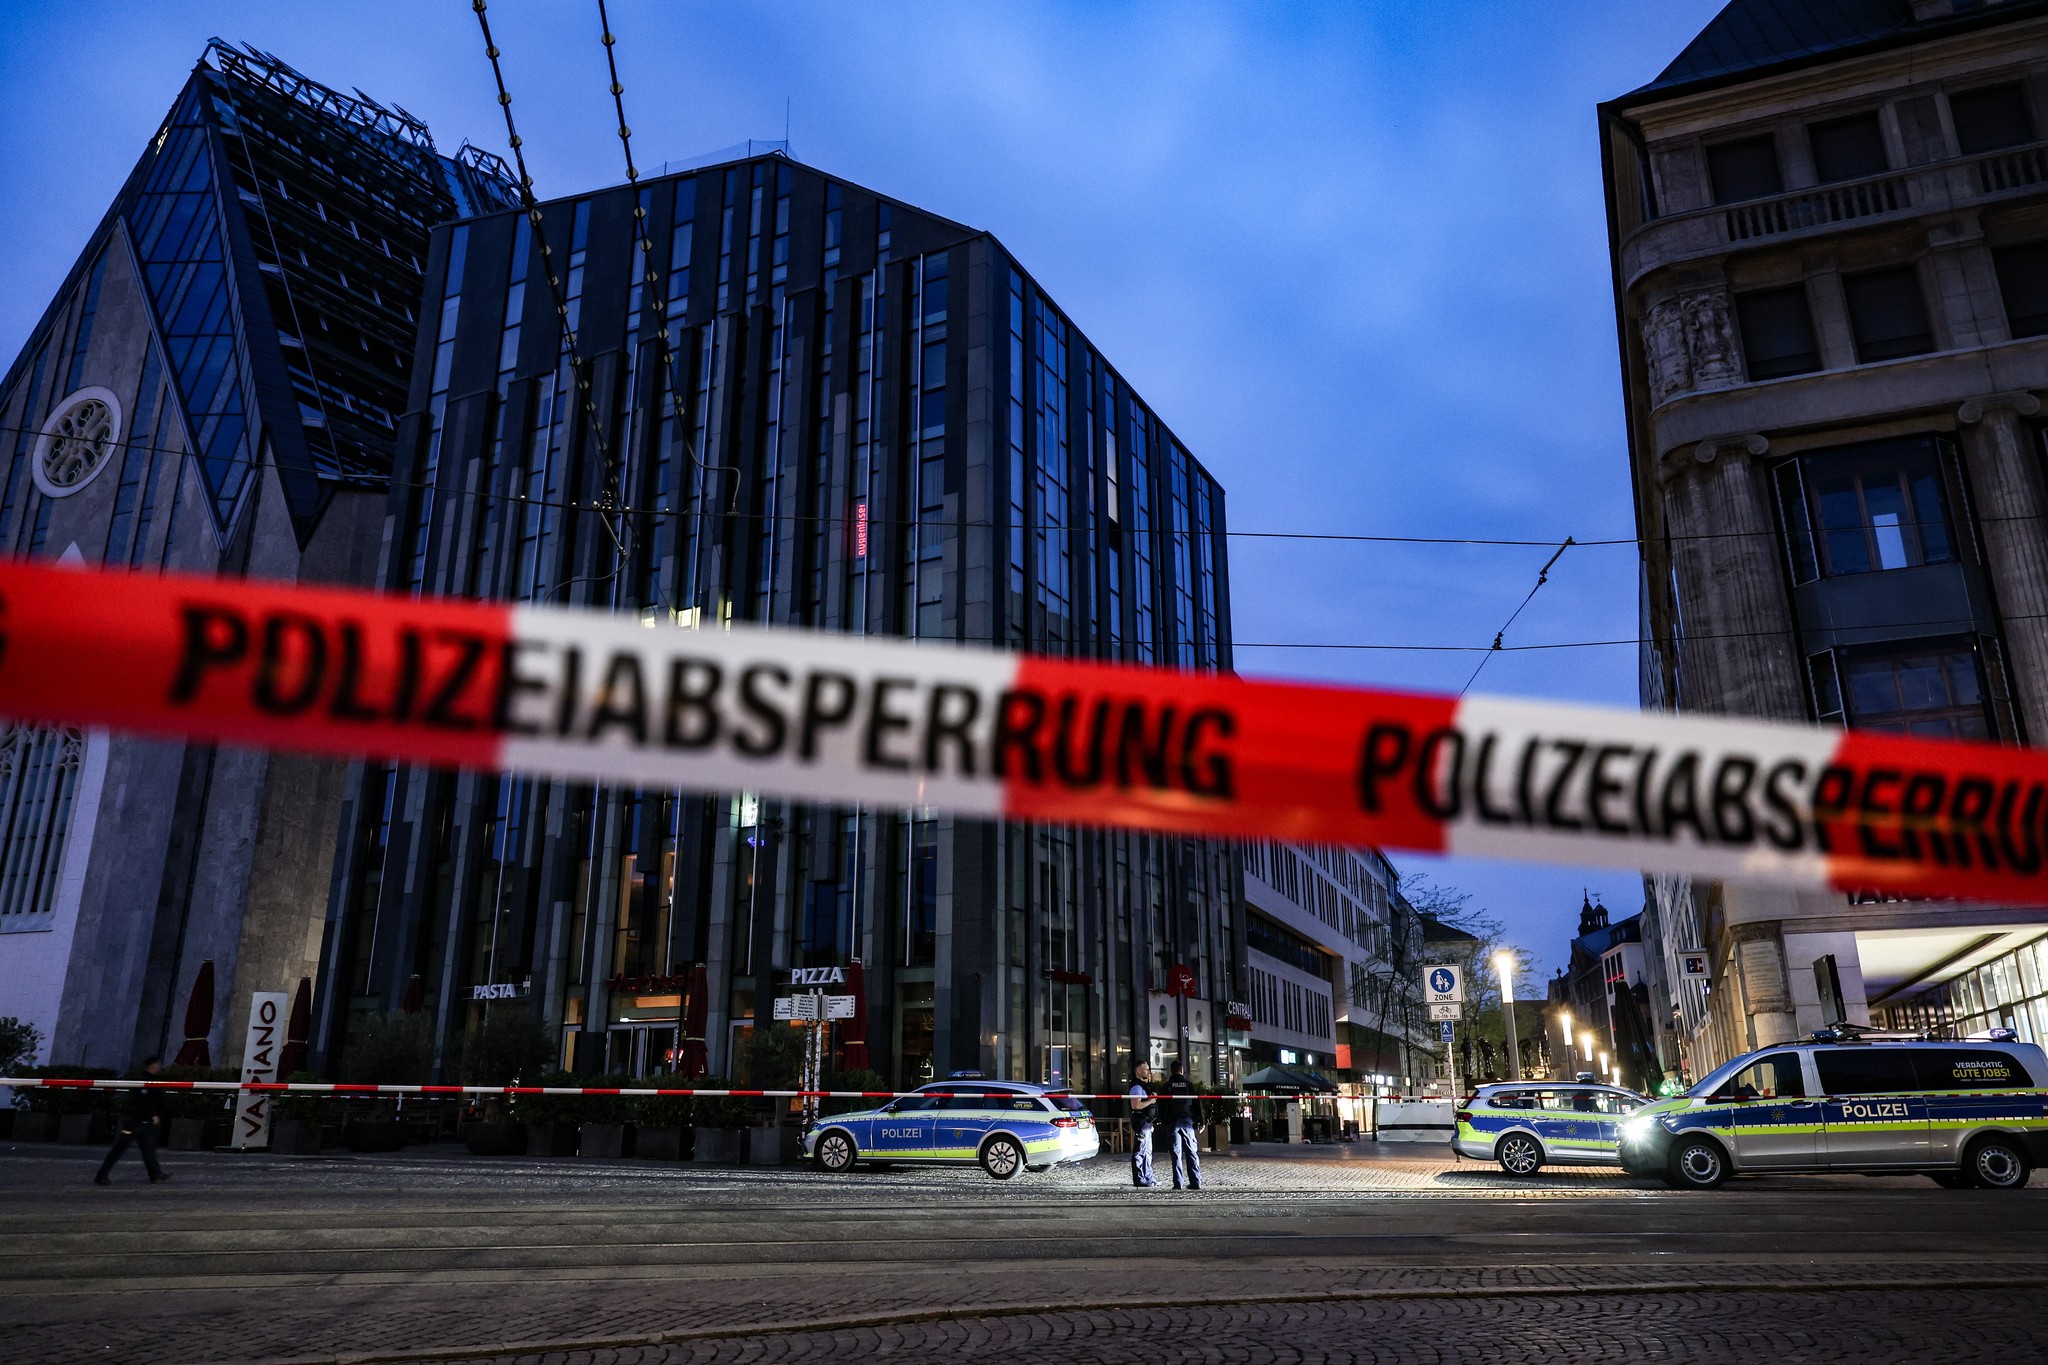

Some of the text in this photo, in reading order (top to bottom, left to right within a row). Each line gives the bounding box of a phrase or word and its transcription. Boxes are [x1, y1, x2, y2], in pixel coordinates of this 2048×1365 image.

[168, 602, 1236, 798] POLIZEIABSPERRUNG
[1358, 718, 2048, 876] POLIZEIABSPERRU
[791, 966, 844, 985] PIZZA
[473, 983, 517, 1000] PASTA
[1228, 1000, 1251, 1017] CENTRAL
[1182, 1026, 1189, 1038] 16
[1952, 1067, 2011, 1078] GUTE JOBS!
[1955, 1061, 2003, 1069] VERDÄCHTIG
[1842, 1103, 1909, 1118] POLIZEI
[881, 1127, 922, 1140] POLIZEI
